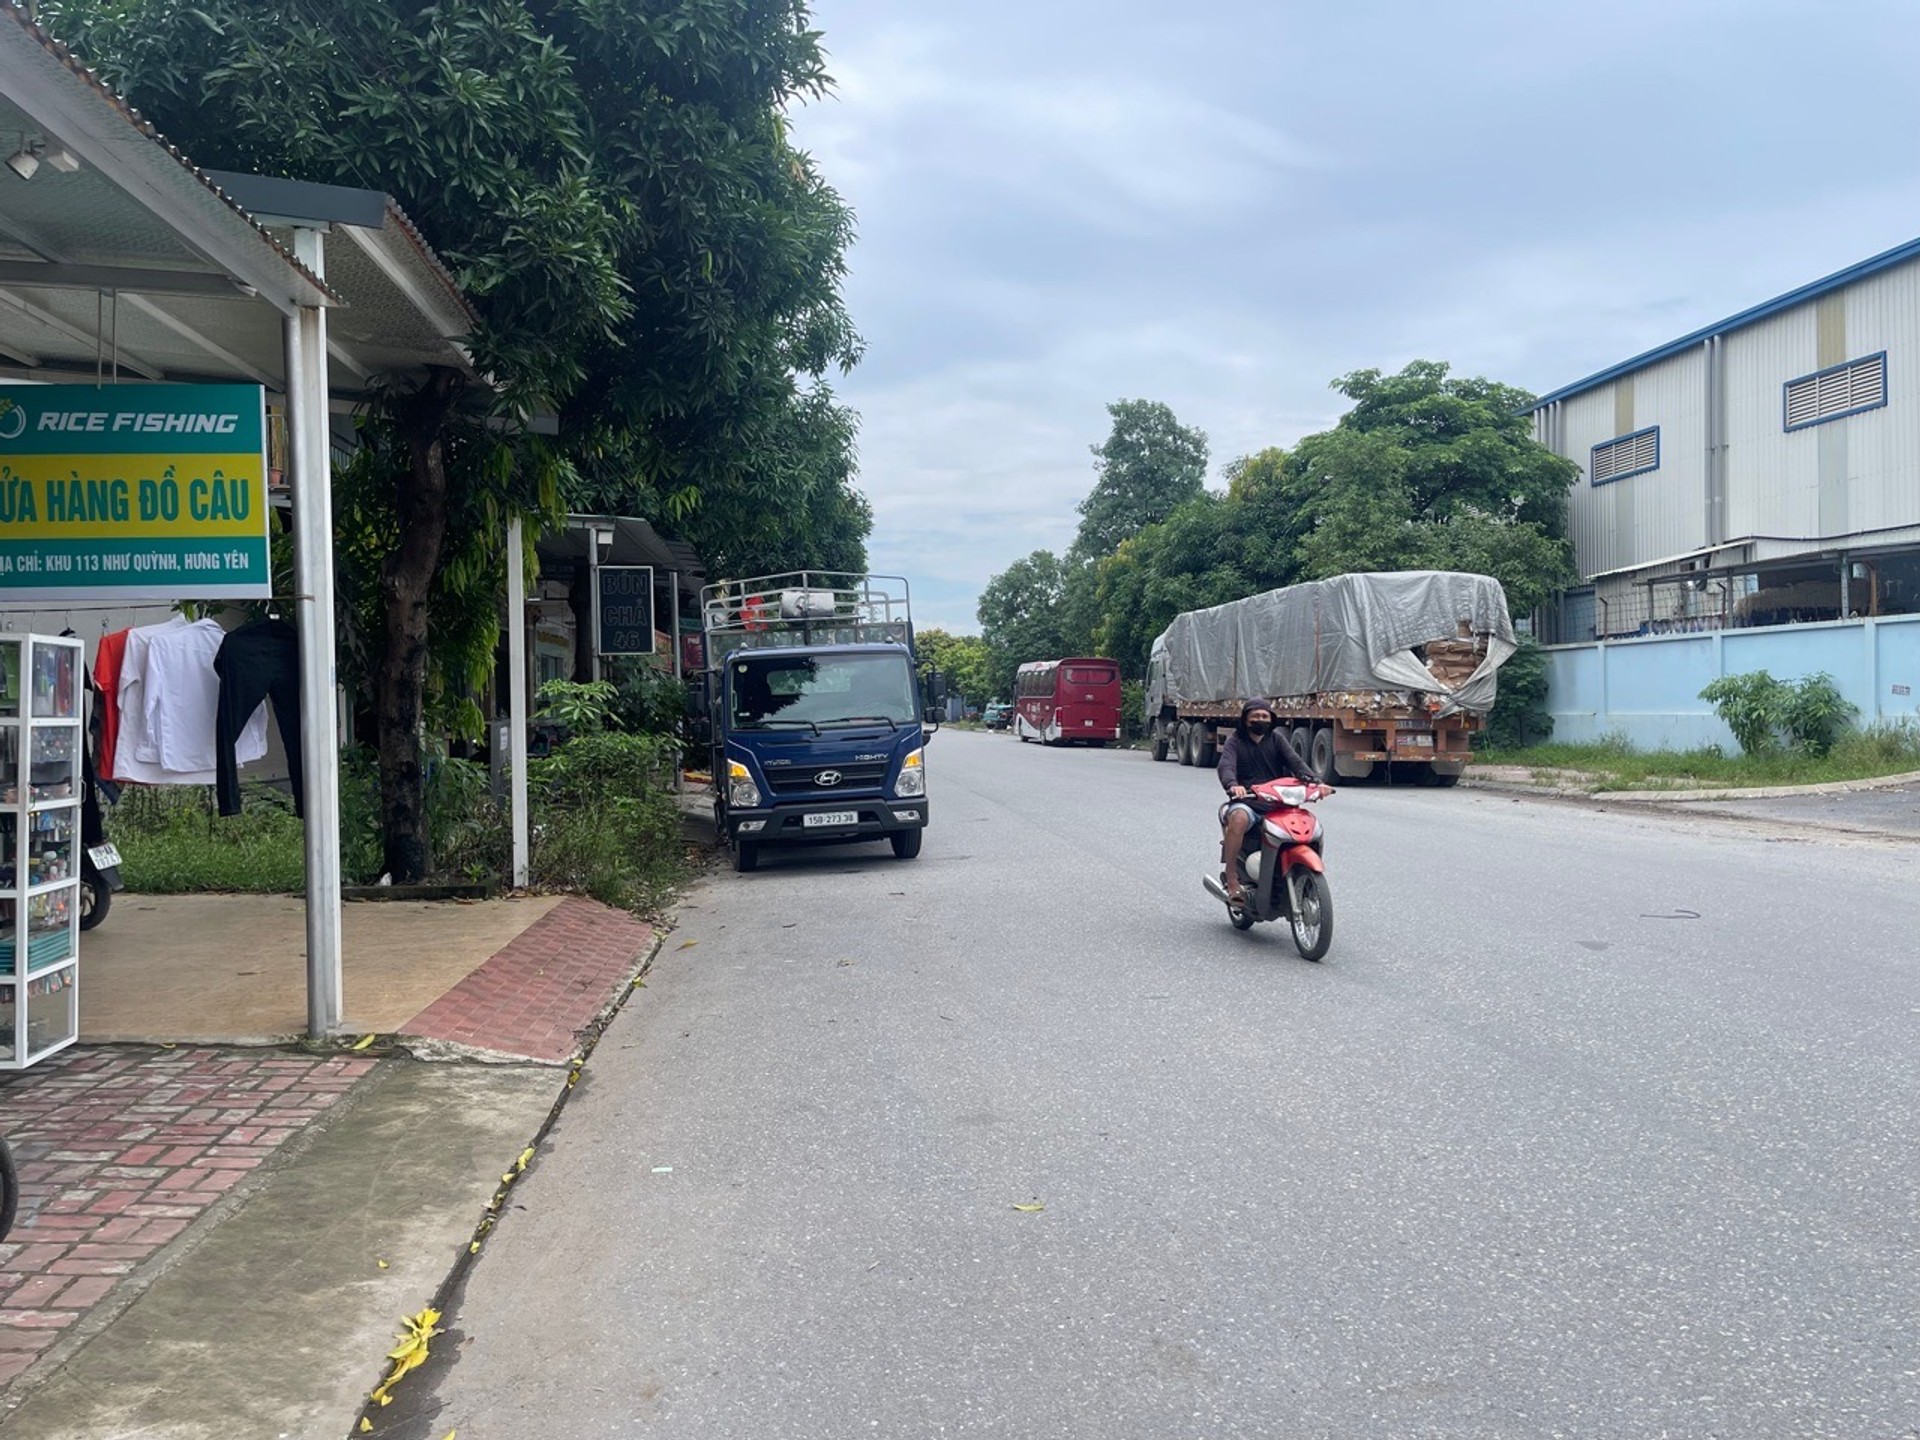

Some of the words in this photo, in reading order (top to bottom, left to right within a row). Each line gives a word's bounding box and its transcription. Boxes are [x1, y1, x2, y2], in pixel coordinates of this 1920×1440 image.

[37, 412, 109, 431] RICE
[112, 413, 239, 433] FISHING
[46, 470, 129, 522] HÀNG
[139, 465, 180, 522] ĐỒ
[189, 469, 250, 521] CÂU
[16, 549, 43, 572] CHỈ:
[45, 554, 72, 572] KHU
[75, 554, 99, 571] 113
[102, 552, 131, 571] NHƯ
[133, 550, 181, 573] QUỲNH,
[184, 552, 220, 570] HƯNG
[223, 549, 249, 570] YÊN
[603, 570, 648, 596] BÚN
[603, 598, 649, 627] CHẢ
[613, 630, 640, 650] 46
